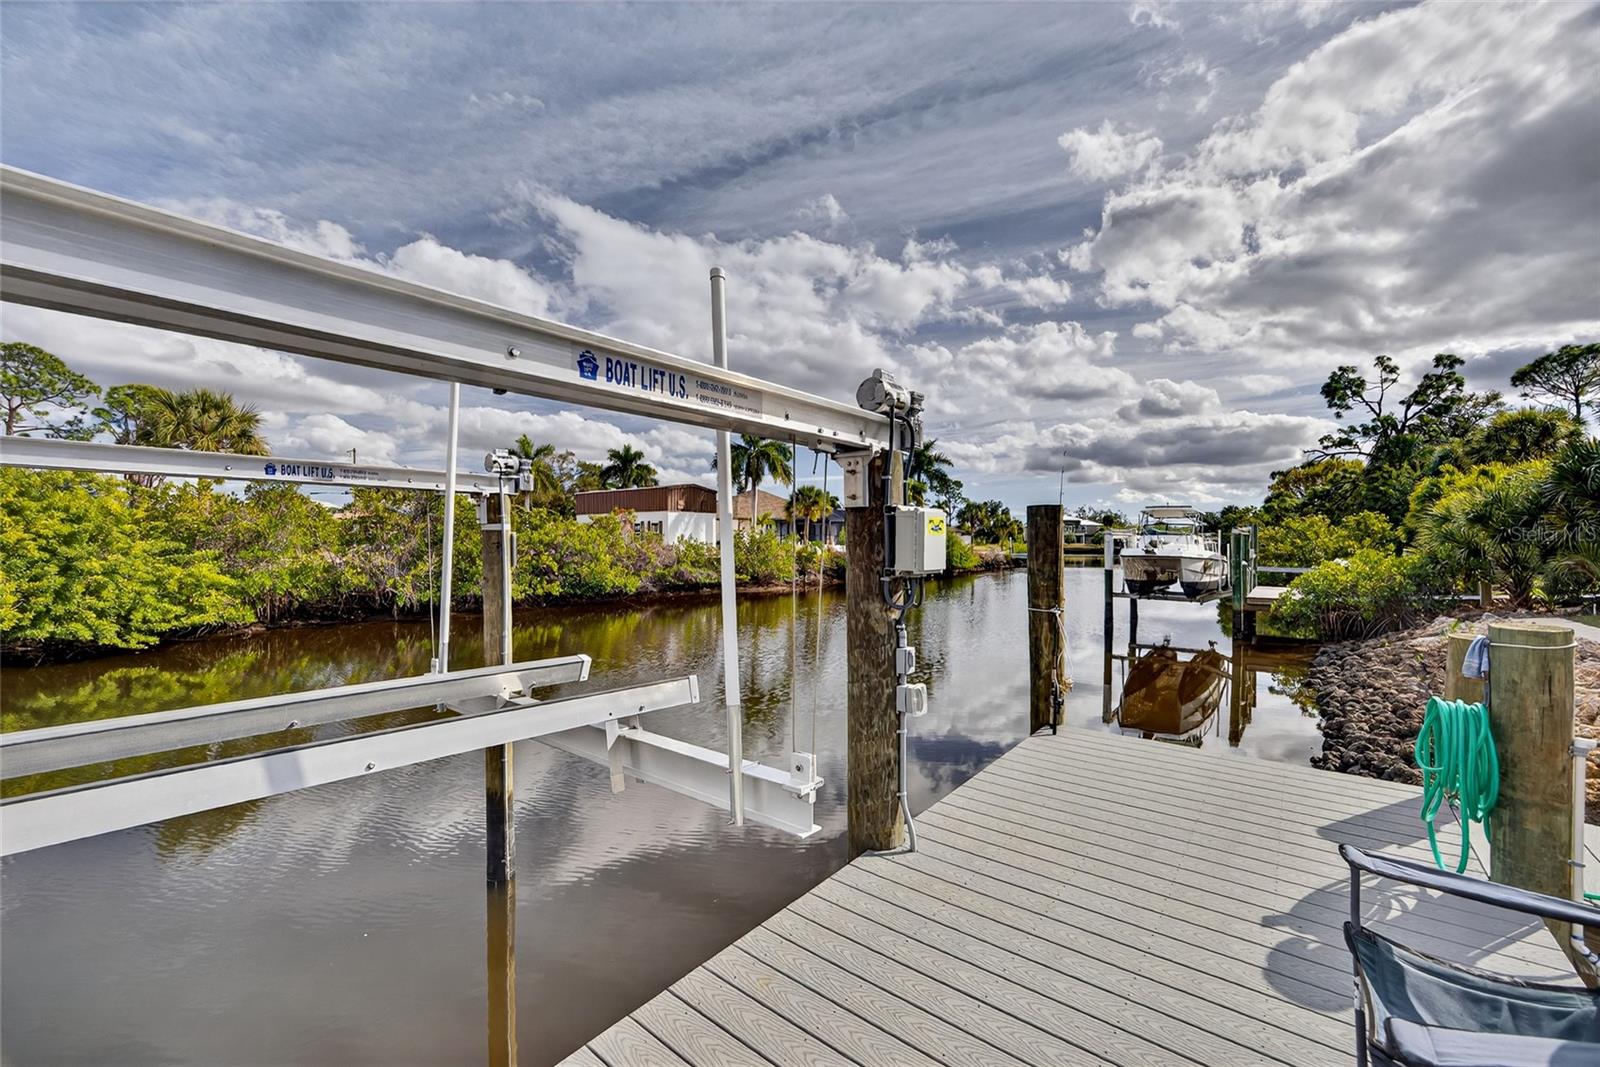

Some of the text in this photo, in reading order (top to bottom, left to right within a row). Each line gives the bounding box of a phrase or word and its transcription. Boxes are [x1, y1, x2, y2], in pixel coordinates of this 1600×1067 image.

[606, 357, 637, 387] BOAT
[641, 366, 665, 394] LIFT
[669, 373, 689, 399] U.S.
[281, 464, 300, 476] BOAT
[303, 466, 320, 477] LIFT
[321, 467, 336, 479] U.S.
